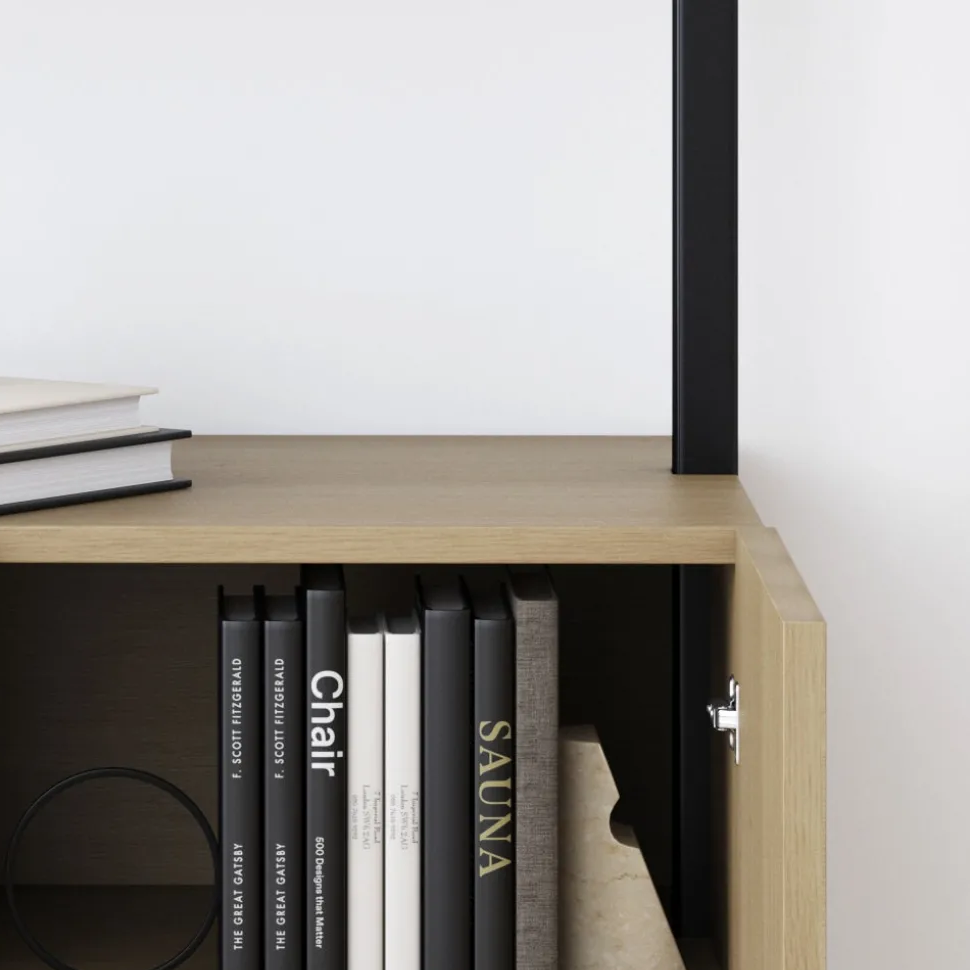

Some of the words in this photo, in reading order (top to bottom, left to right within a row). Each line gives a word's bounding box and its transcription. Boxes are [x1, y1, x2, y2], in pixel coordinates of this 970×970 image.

[232, 658, 242, 725] FITZGERALD
[274, 658, 284, 725] FITZGERALD
[311, 669, 344, 777] Chair
[232, 730, 242, 764] SCOTT
[274, 730, 284, 764] SCOTT
[232, 769, 242, 778] F.
[274, 769, 284, 778] F.
[478, 720, 511, 878] SAUNA
[315, 836, 325, 856] 500
[233, 843, 243, 885] GATSBY
[275, 843, 285, 885] GATSBY
[313, 858, 325, 895] Designs
[233, 890, 243, 926] GREAT
[275, 890, 285, 926] GREAT
[315, 896, 325, 915] that
[233, 931, 243, 951] THE
[275, 931, 285, 951] THE
[315, 917, 325, 949] Matter
